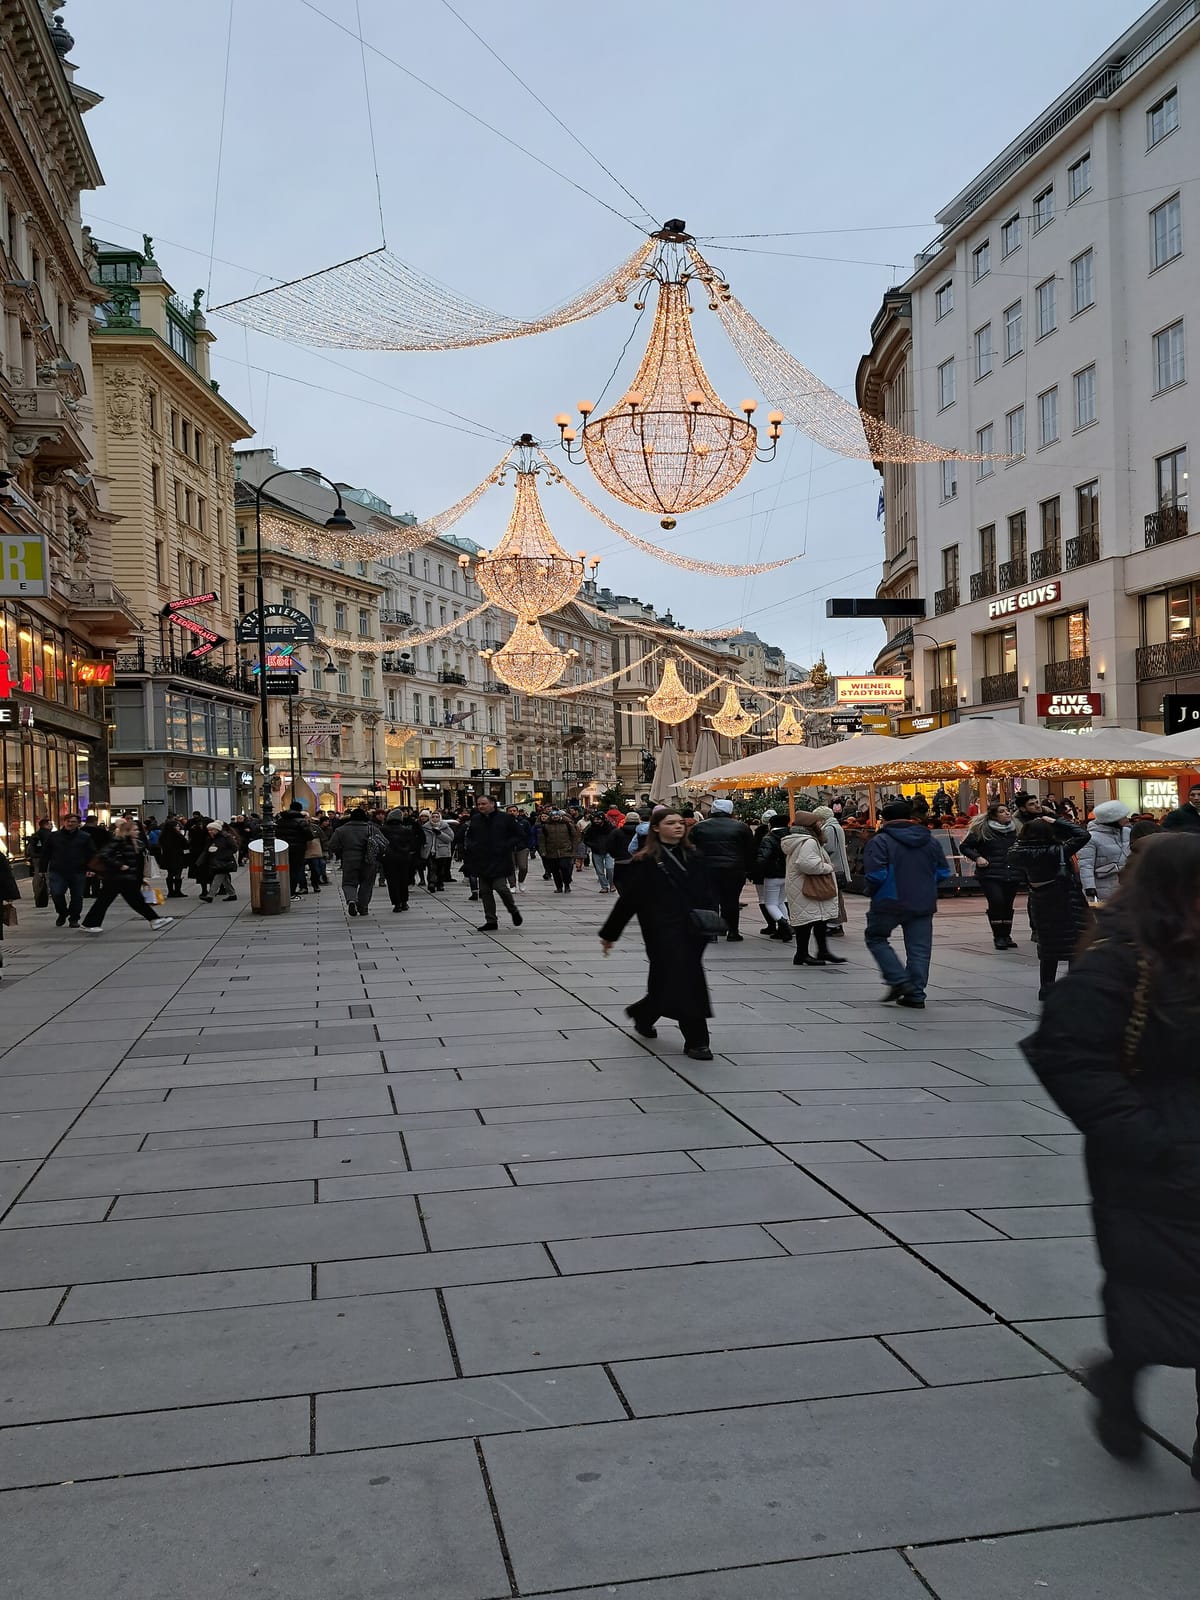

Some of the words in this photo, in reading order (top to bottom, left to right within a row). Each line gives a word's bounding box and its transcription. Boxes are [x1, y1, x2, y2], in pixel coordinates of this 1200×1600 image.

[989, 595, 1018, 618] FIVE
[1018, 584, 1057, 609] GUYS
[168, 613, 218, 642] FLEDERMAUS
[1052, 695, 1088, 705] FIVE
[1048, 705, 1093, 715] GUYS
[1146, 781, 1178, 795] FIVE
[1143, 795, 1179, 809] GUYS
